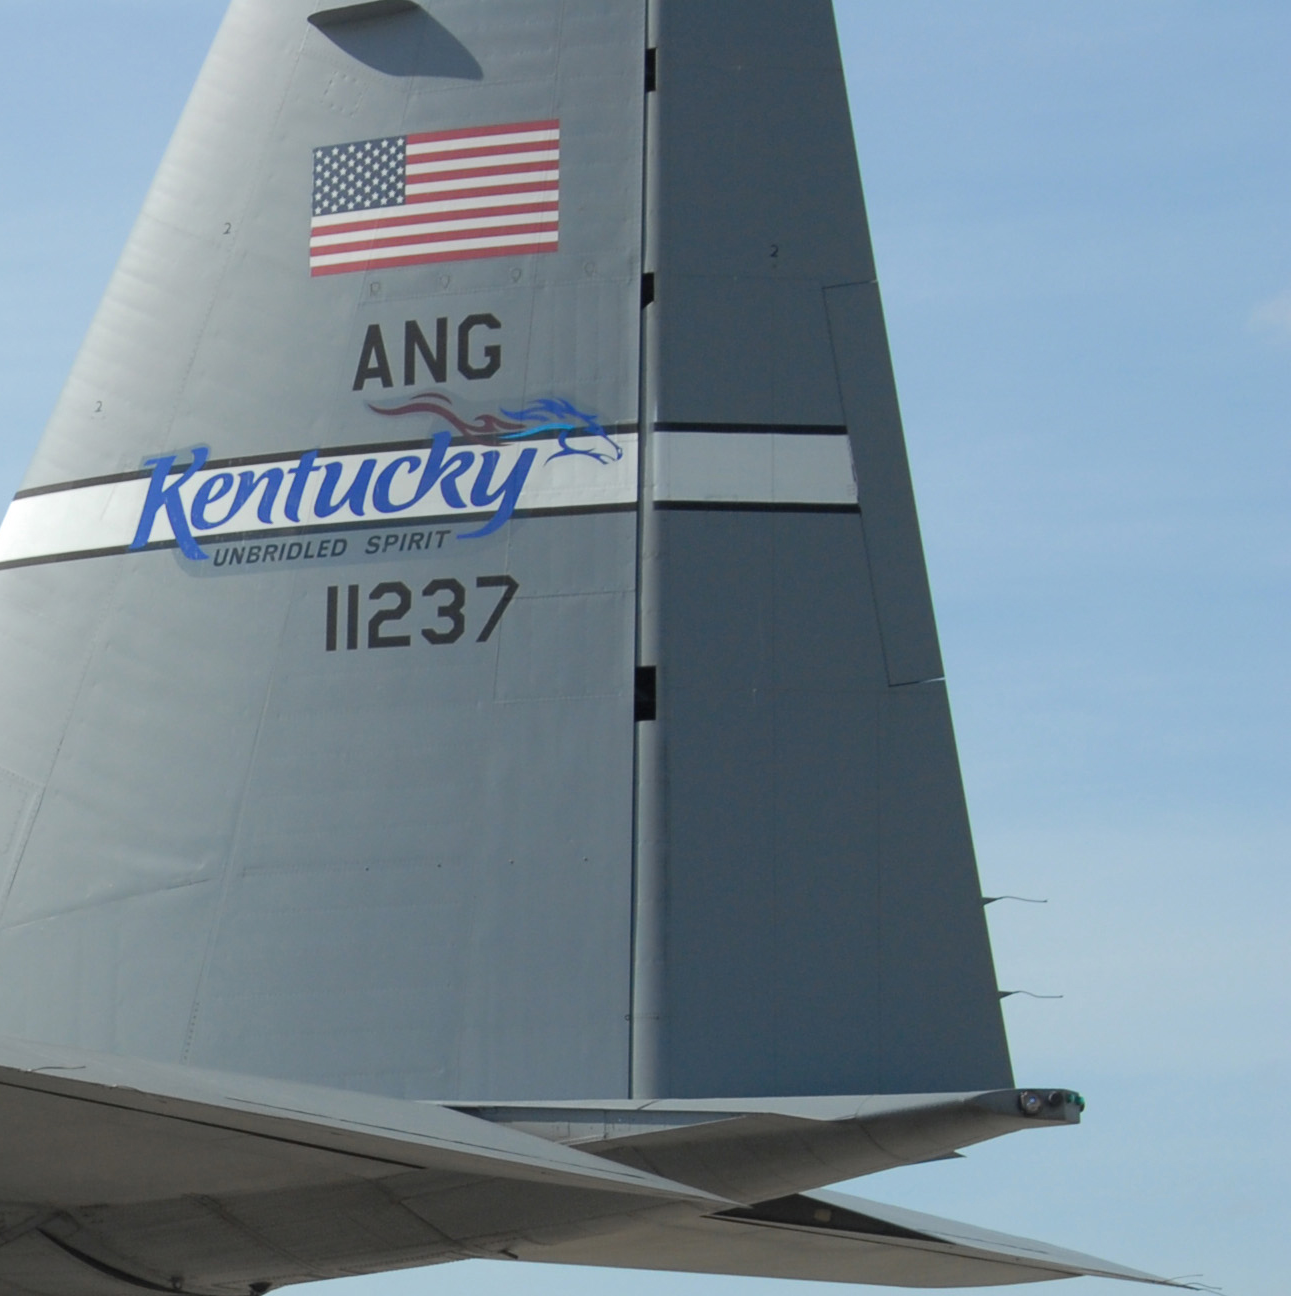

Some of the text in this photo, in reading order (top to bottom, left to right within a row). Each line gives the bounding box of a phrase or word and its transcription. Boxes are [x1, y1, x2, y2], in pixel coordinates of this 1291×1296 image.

[351, 312, 502, 392] ANG
[127, 430, 538, 560] Kentucky
[212, 530, 451, 567] UNBRIDLED SPIRIT
[325, 575, 519, 651] 11237
